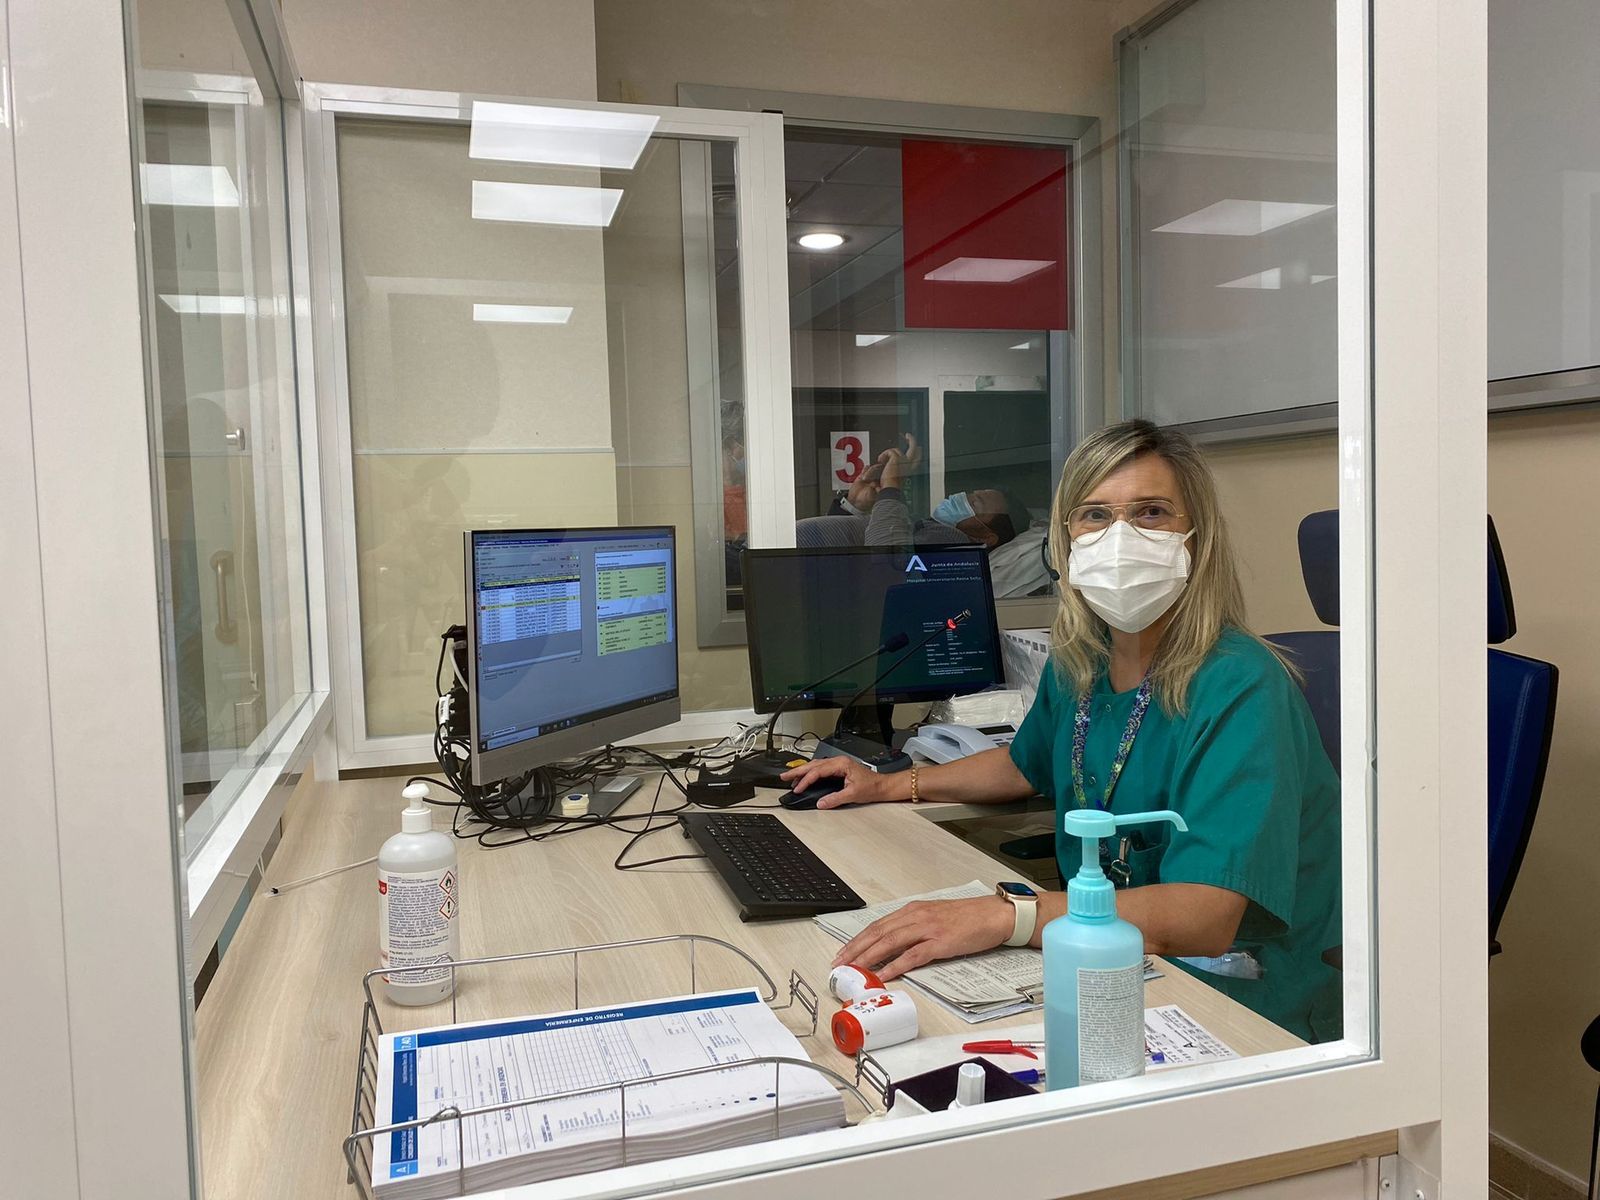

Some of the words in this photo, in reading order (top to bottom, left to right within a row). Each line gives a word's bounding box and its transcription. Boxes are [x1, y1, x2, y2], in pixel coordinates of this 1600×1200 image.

[835, 436, 865, 484] 3
[594, 1012, 624, 1021] REGISTRO
[545, 1017, 584, 1027] ENFERMERÍA
